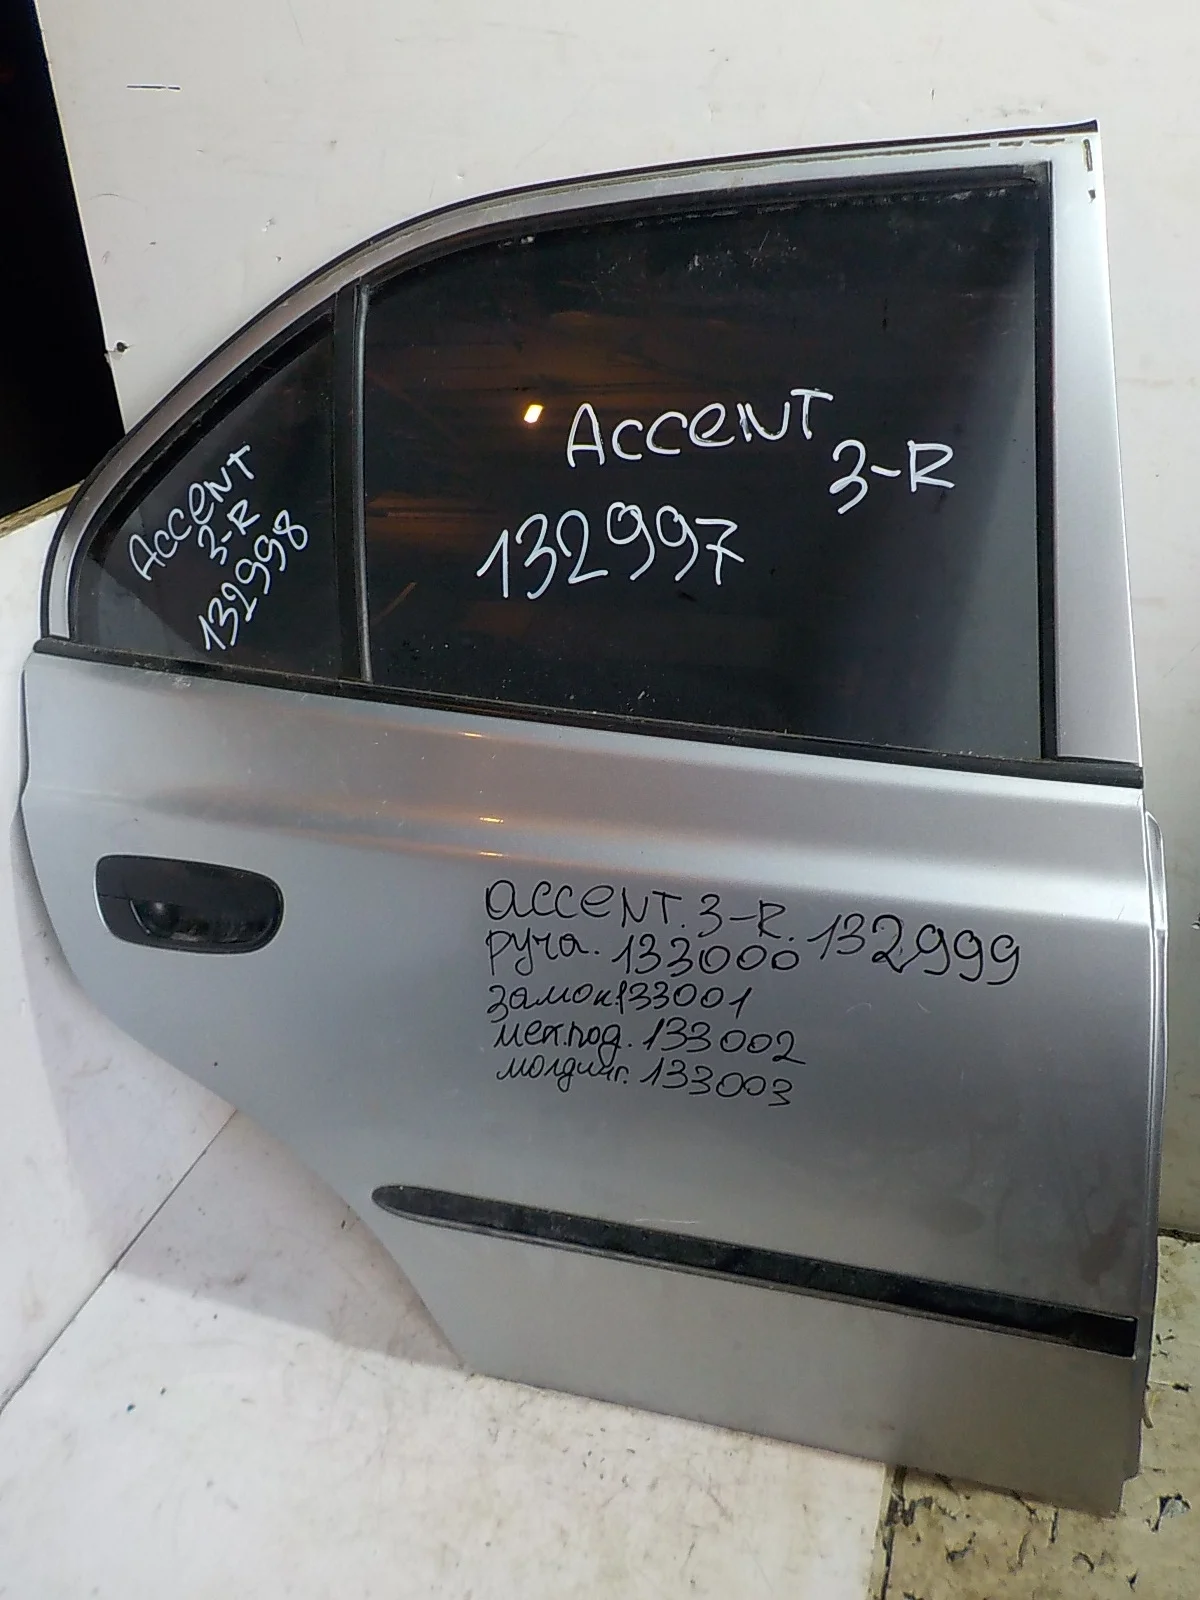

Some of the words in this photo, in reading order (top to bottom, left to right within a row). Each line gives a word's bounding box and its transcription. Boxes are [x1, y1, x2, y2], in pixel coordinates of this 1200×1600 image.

[829, 440, 955, 514] 3-R
[198, 499, 261, 565] 3-R
[476, 502, 745, 600] 132997
[198, 509, 308, 650] 132998
[611, 934, 799, 978] 133000
[807, 913, 1020, 985] 132999
[642, 1017, 806, 1065] 133002
[639, 1057, 792, 1106] 133003
